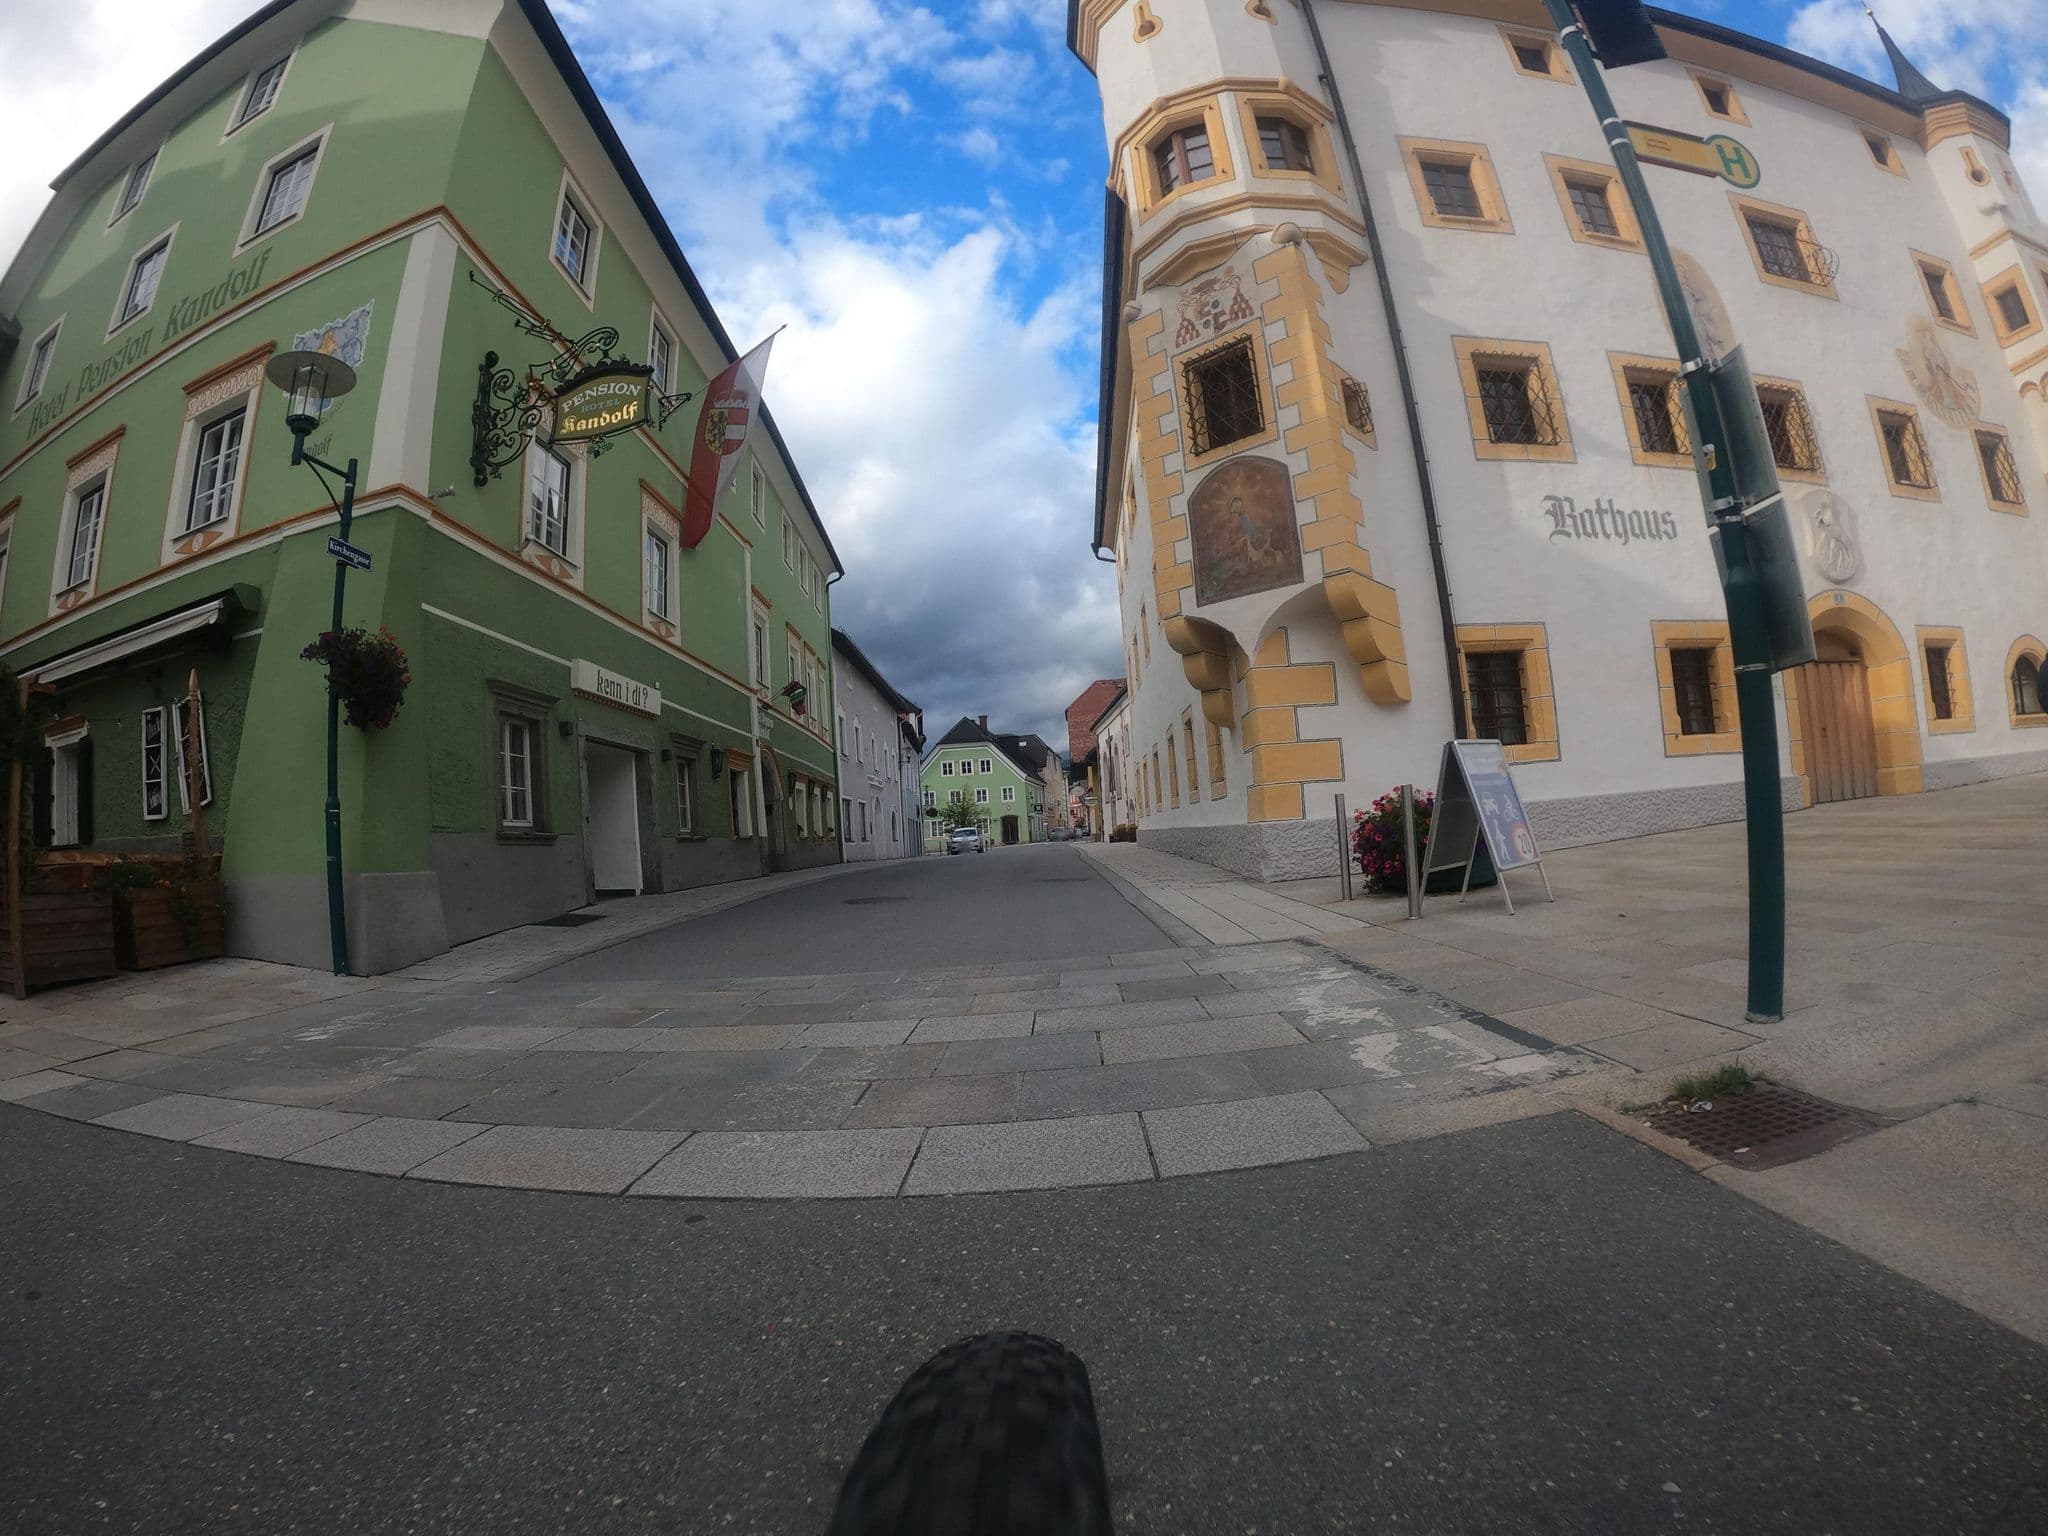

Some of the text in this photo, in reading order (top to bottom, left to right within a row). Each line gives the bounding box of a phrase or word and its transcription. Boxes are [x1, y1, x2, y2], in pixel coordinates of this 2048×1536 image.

[1717, 144, 1752, 178] H
[27, 246, 273, 440] Hotel Pension Kandolf
[562, 382, 642, 413] PENSION
[581, 399, 621, 413] HOTEL
[560, 401, 639, 434] Kandolf
[1542, 495, 1678, 546] Rathaus
[329, 540, 370, 566] Kirchengasse
[597, 669, 622, 700] kenn
[624, 681, 629, 703] i
[1517, 832, 1532, 855] 20
